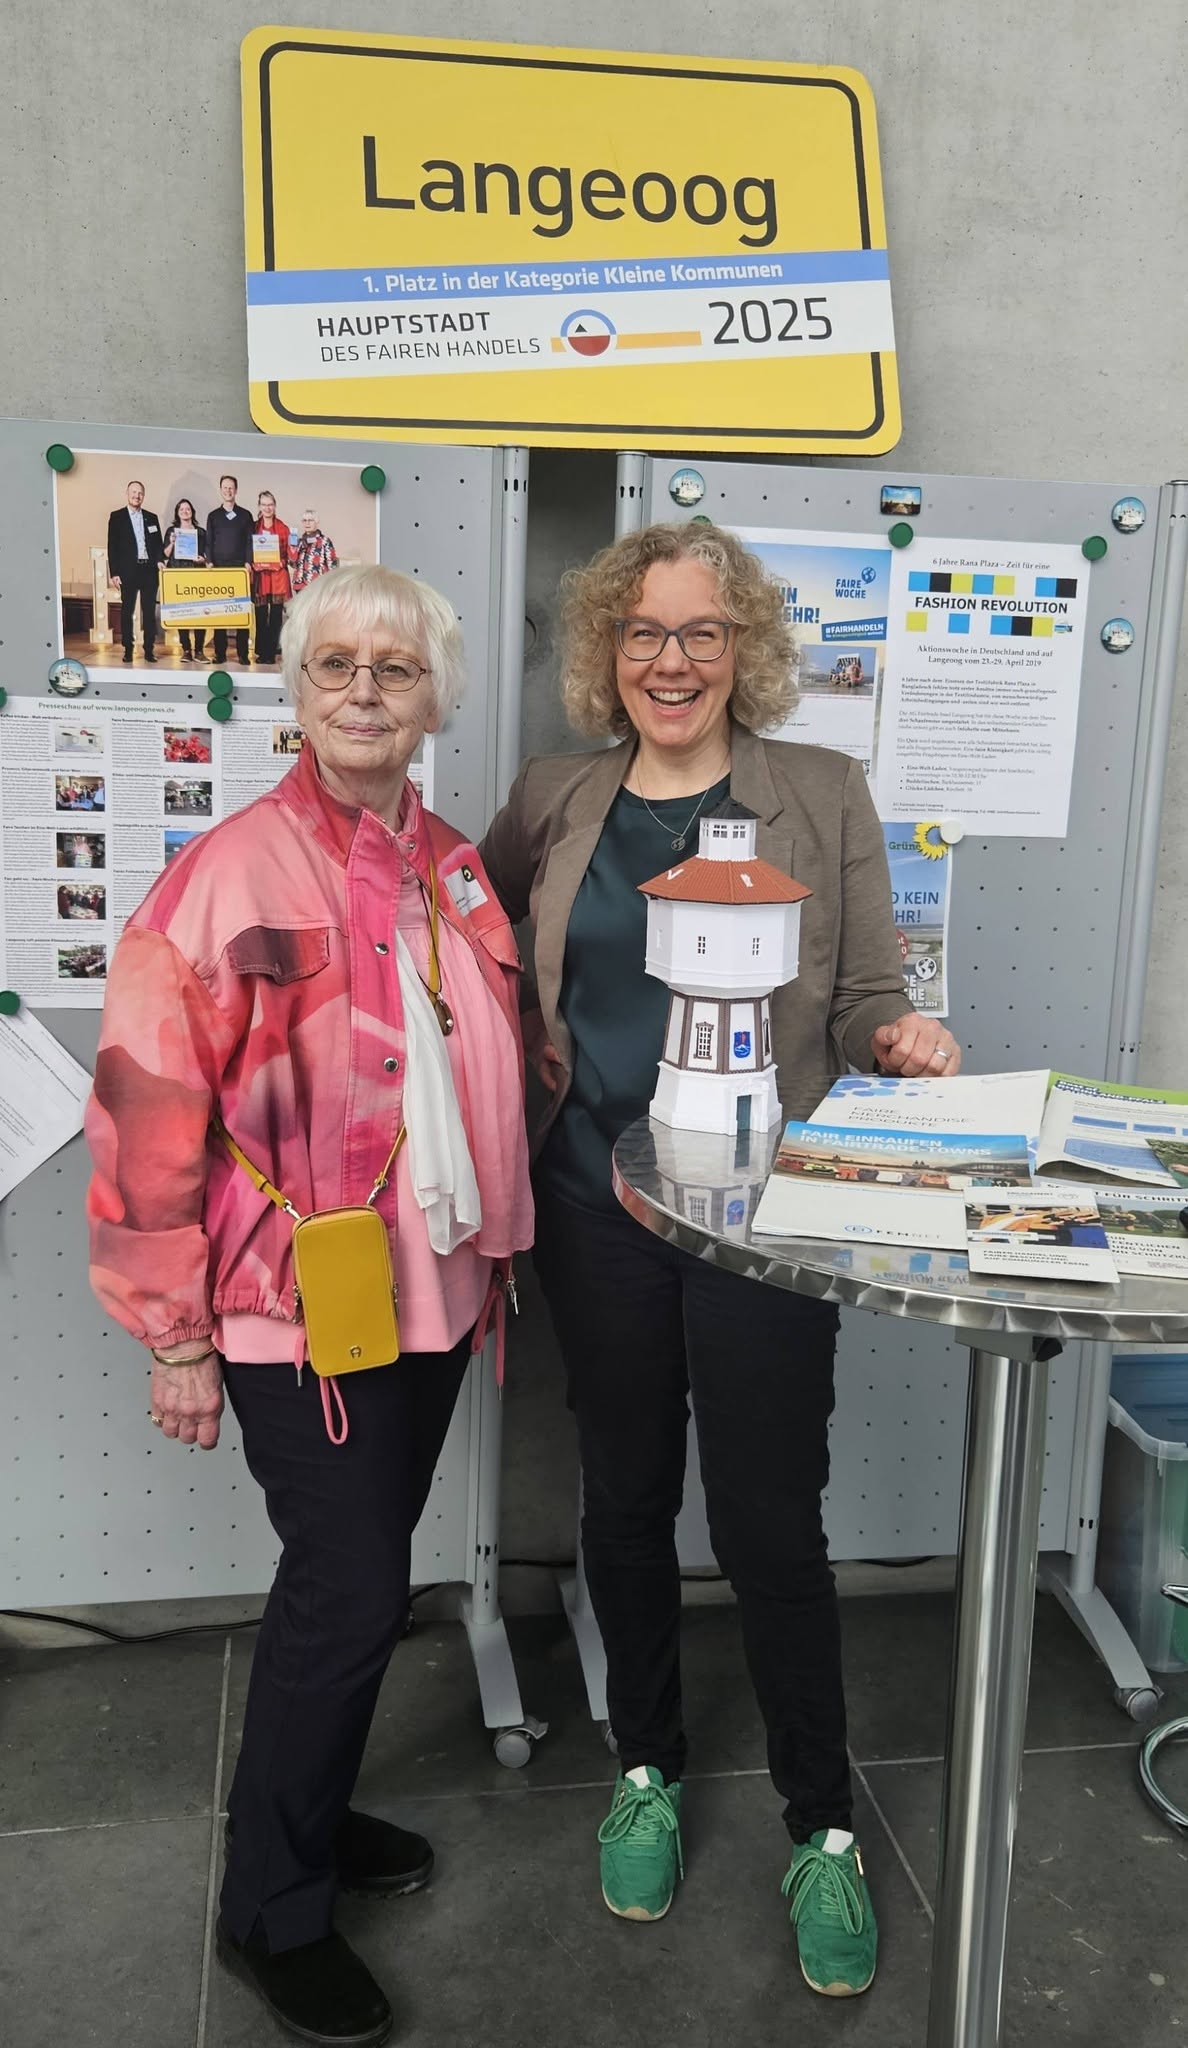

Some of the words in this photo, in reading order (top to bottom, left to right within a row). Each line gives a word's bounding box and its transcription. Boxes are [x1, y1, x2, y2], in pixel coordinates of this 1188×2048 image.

[363, 134, 779, 248] Langeoog
[363, 276, 380, 293] 1.
[386, 274, 437, 292] Platz
[443, 272, 462, 290] in
[467, 271, 499, 290] der
[504, 267, 600, 291] Kategorie
[604, 264, 666, 285] Kleine
[671, 262, 784, 283] Kommunen
[317, 311, 491, 338] HAUPTSTADT
[708, 296, 833, 346] 2025
[320, 342, 360, 364] DES
[363, 339, 441, 361] FAIREN
[446, 335, 541, 358] HANDELS
[938, 557, 958, 567] Jahre
[960, 559, 978, 567] Rana
[980, 559, 999, 568] Plaza
[1006, 560, 1021, 569] Zeit
[1022, 561, 1034, 570] für
[1034, 562, 1051, 570] eine
[176, 583, 235, 598] Langeoog
[836, 579, 862, 589] FAIRE
[835, 589, 866, 599] WOCHE
[224, 604, 243, 613] 2025
[915, 596, 977, 610] FASHION
[981, 599, 1068, 614] REVOLUTION
[825, 623, 884, 634] #FAIRHANDELN
[917, 645, 969, 655] Aktionswoche
[970, 646, 978, 654] in
[979, 647, 1024, 657] Deutschland
[1026, 649, 1040, 657] und
[1042, 650, 1053, 658] auf
[928, 655, 963, 667] Langeoog
[964, 657, 980, 665] vom
[1005, 658, 1024, 668] April
[1026, 659, 1042, 667] 2019
[38, 702, 82, 711] Presseschau
[904, 891, 939, 905] KEIN
[895, 909, 921, 923] HR!
[801, 1129, 840, 1140] FAIR
[845, 1133, 943, 1147] EINKAUFEN
[800, 1135, 817, 1143] IN
[823, 1138, 992, 1156] FAIRTRADE-TOWNS
